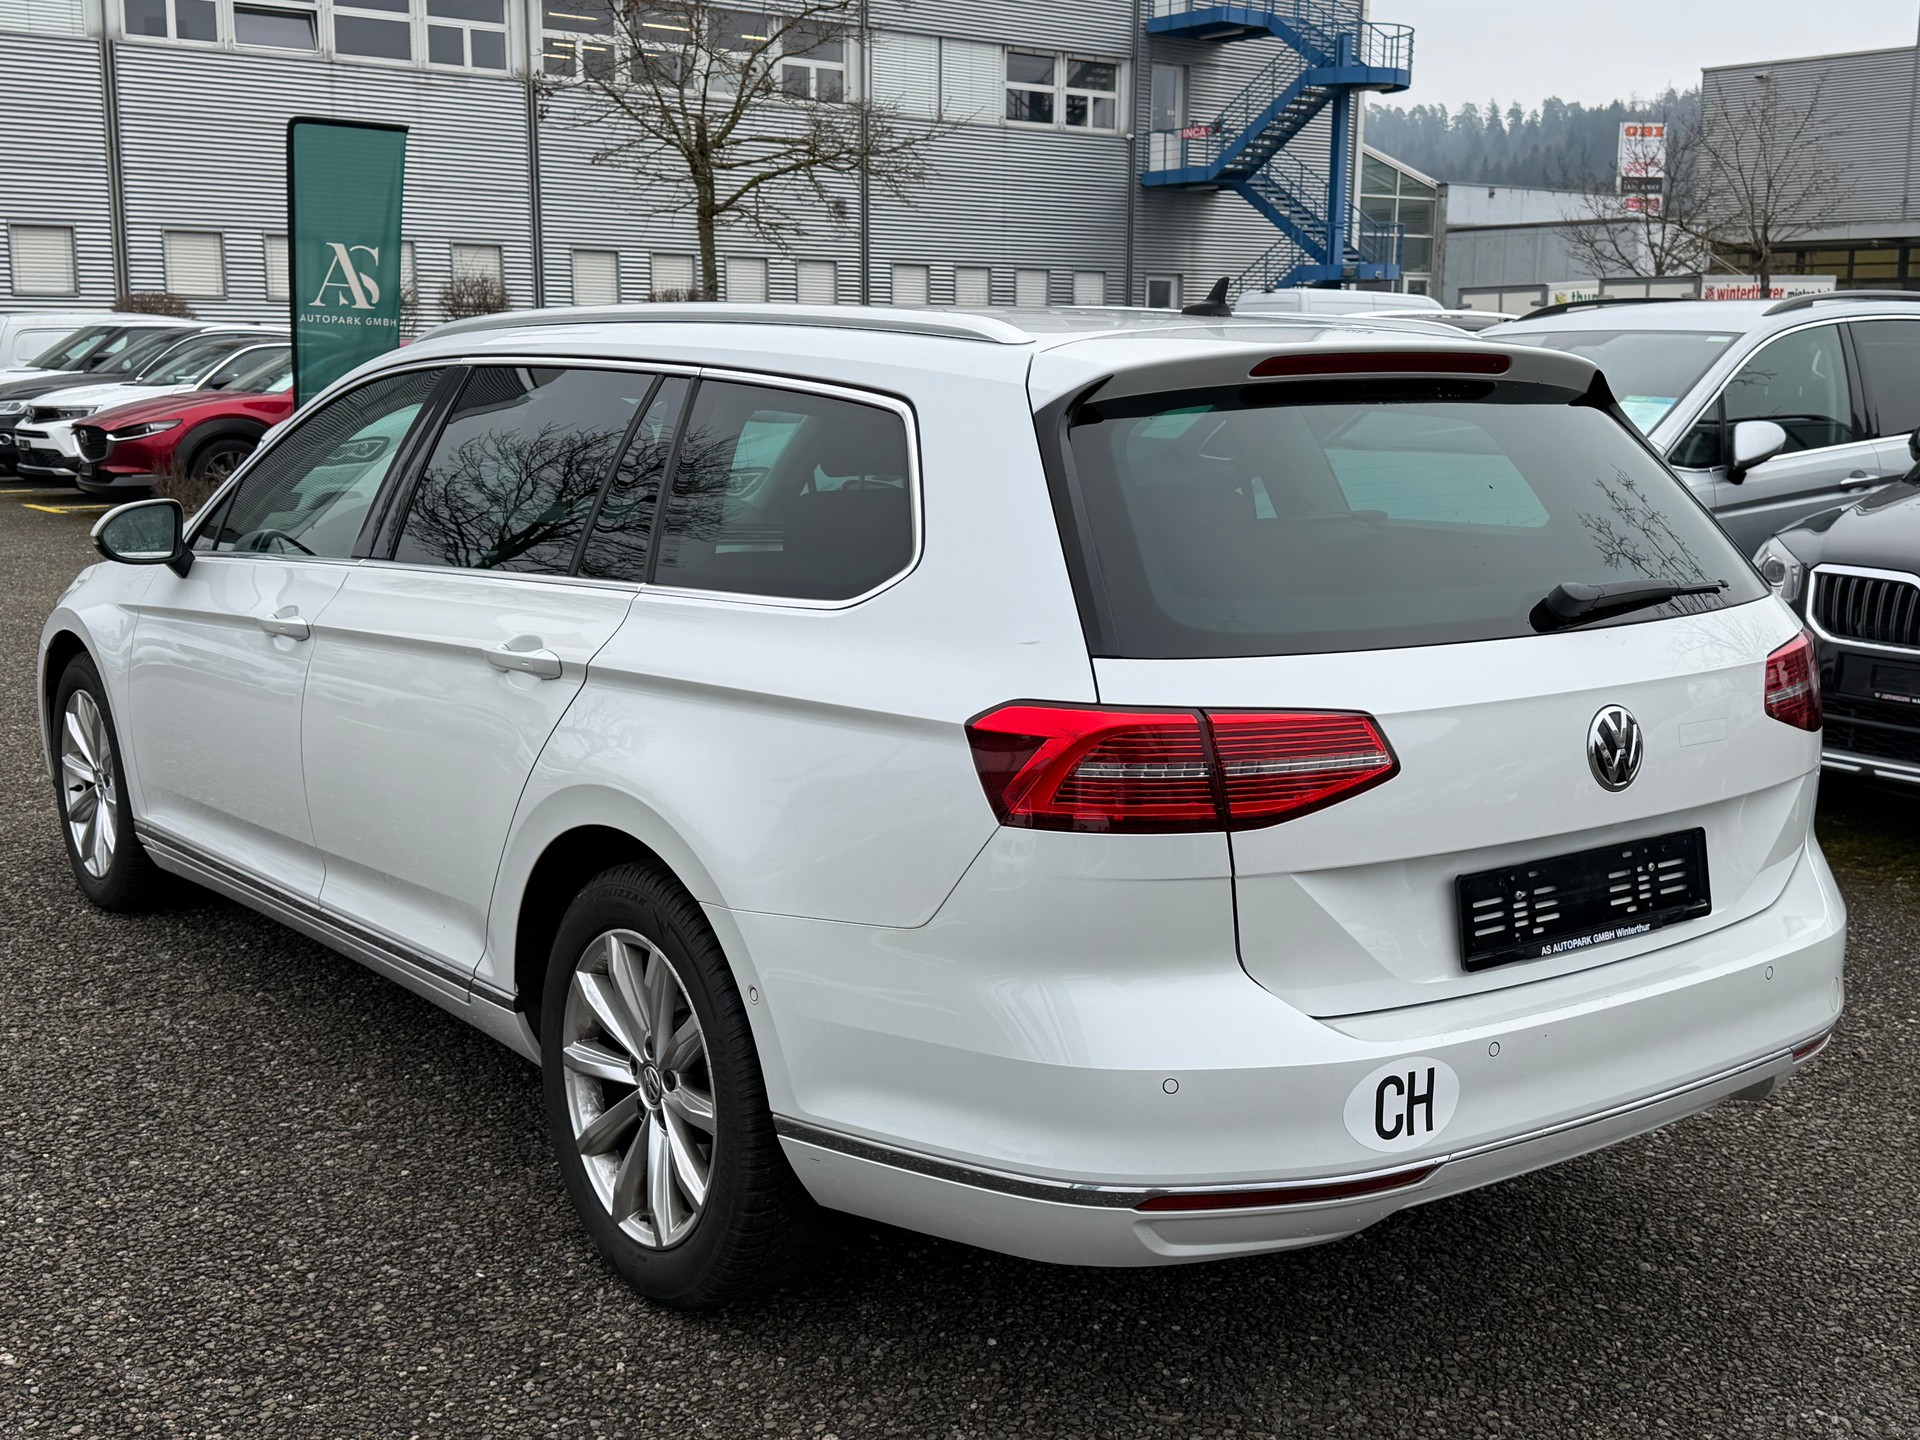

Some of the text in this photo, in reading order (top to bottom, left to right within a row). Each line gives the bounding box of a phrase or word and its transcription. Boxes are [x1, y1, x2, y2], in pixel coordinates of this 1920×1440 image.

[1182, 127, 1207, 138] INCA
[309, 242, 380, 309] AS
[1717, 284, 1784, 299] winterthrer
[300, 314, 397, 327] AUTOPARK GMBH
[1541, 923, 1651, 956] AS AUTOPARK GMBH Winterthur
[1375, 1066, 1435, 1141] CH
